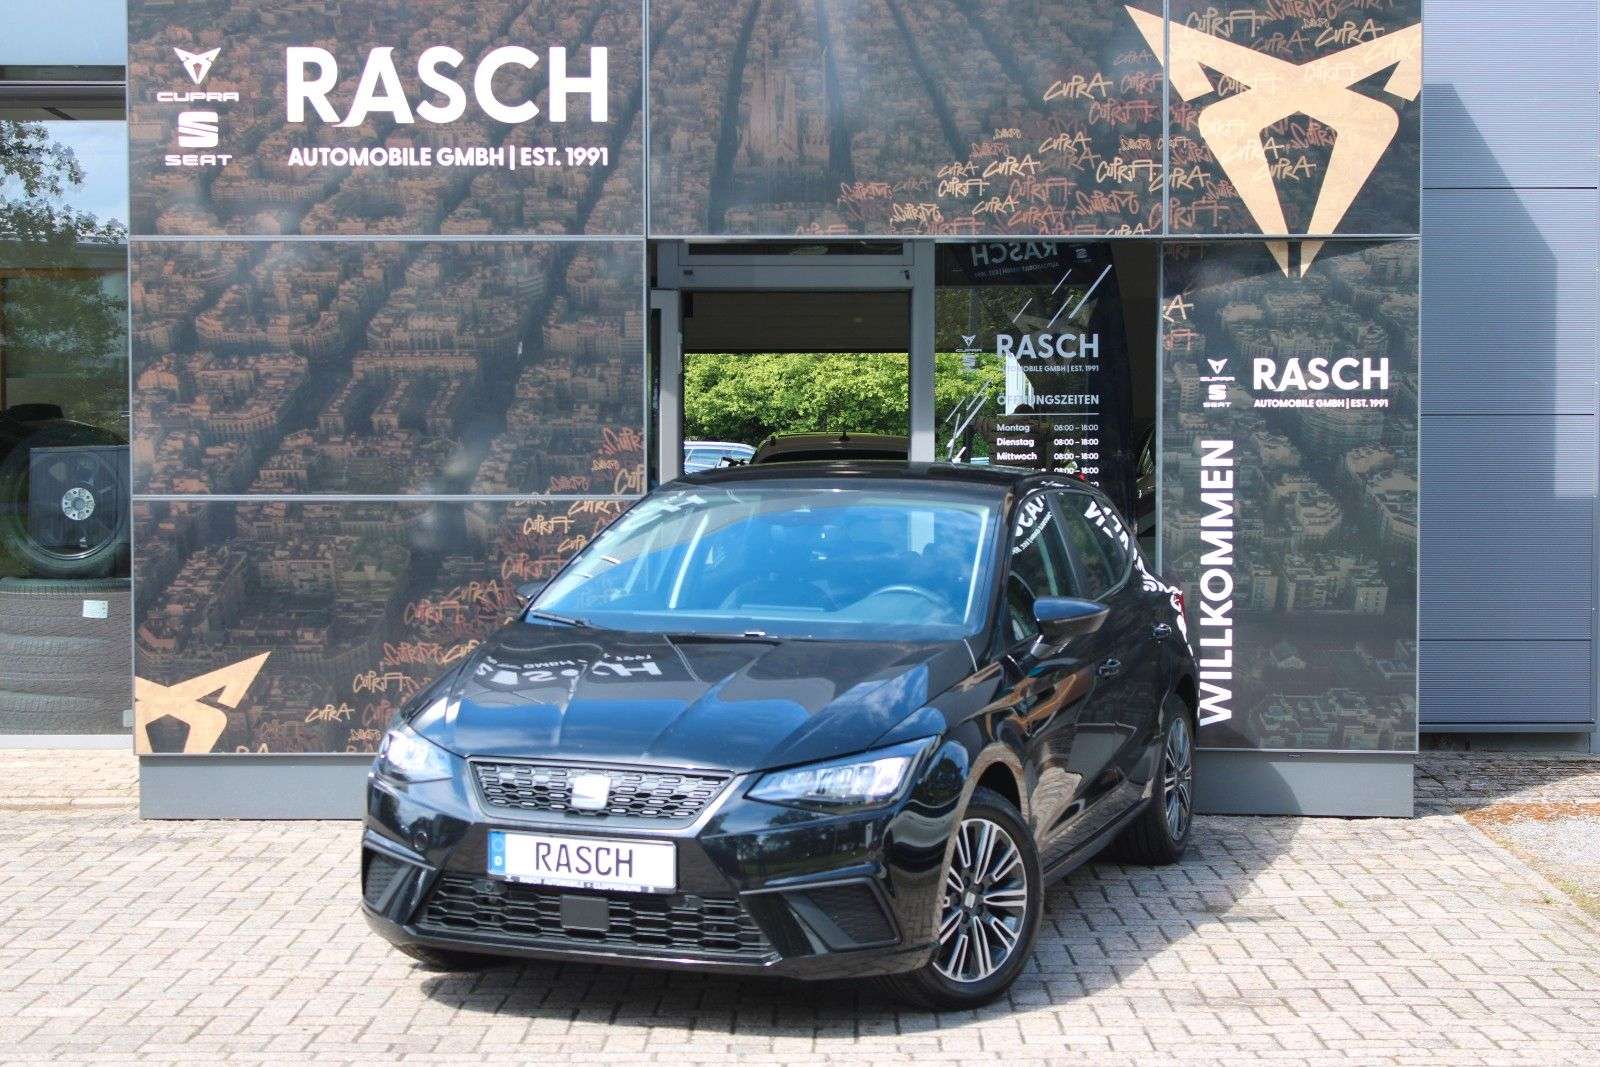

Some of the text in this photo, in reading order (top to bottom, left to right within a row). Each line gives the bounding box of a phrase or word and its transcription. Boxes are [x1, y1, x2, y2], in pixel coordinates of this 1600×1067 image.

[286, 46, 608, 127] RASCH
[157, 92, 239, 102] CUPRA
[164, 154, 233, 166] SEAT
[288, 147, 431, 166] AUTOMOBILE
[436, 147, 504, 166] GMBH
[520, 147, 561, 166] EST.
[565, 147, 608, 166] 1991
[996, 333, 1099, 359] RASCH
[1044, 365, 1065, 373] GMBH
[1253, 357, 1389, 391] RASCH
[1254, 399, 1314, 408] AUTOMOBILE
[1316, 399, 1344, 408] GMBH
[1351, 399, 1368, 408] EST.
[1370, 399, 1389, 408] 1991
[996, 424, 1030, 433] Montag
[996, 438, 1035, 447] Dienstag
[996, 452, 1038, 460] Mittwoch
[1200, 440, 1234, 727] WILLKOMMEN
[536, 842, 633, 877] RASCH
